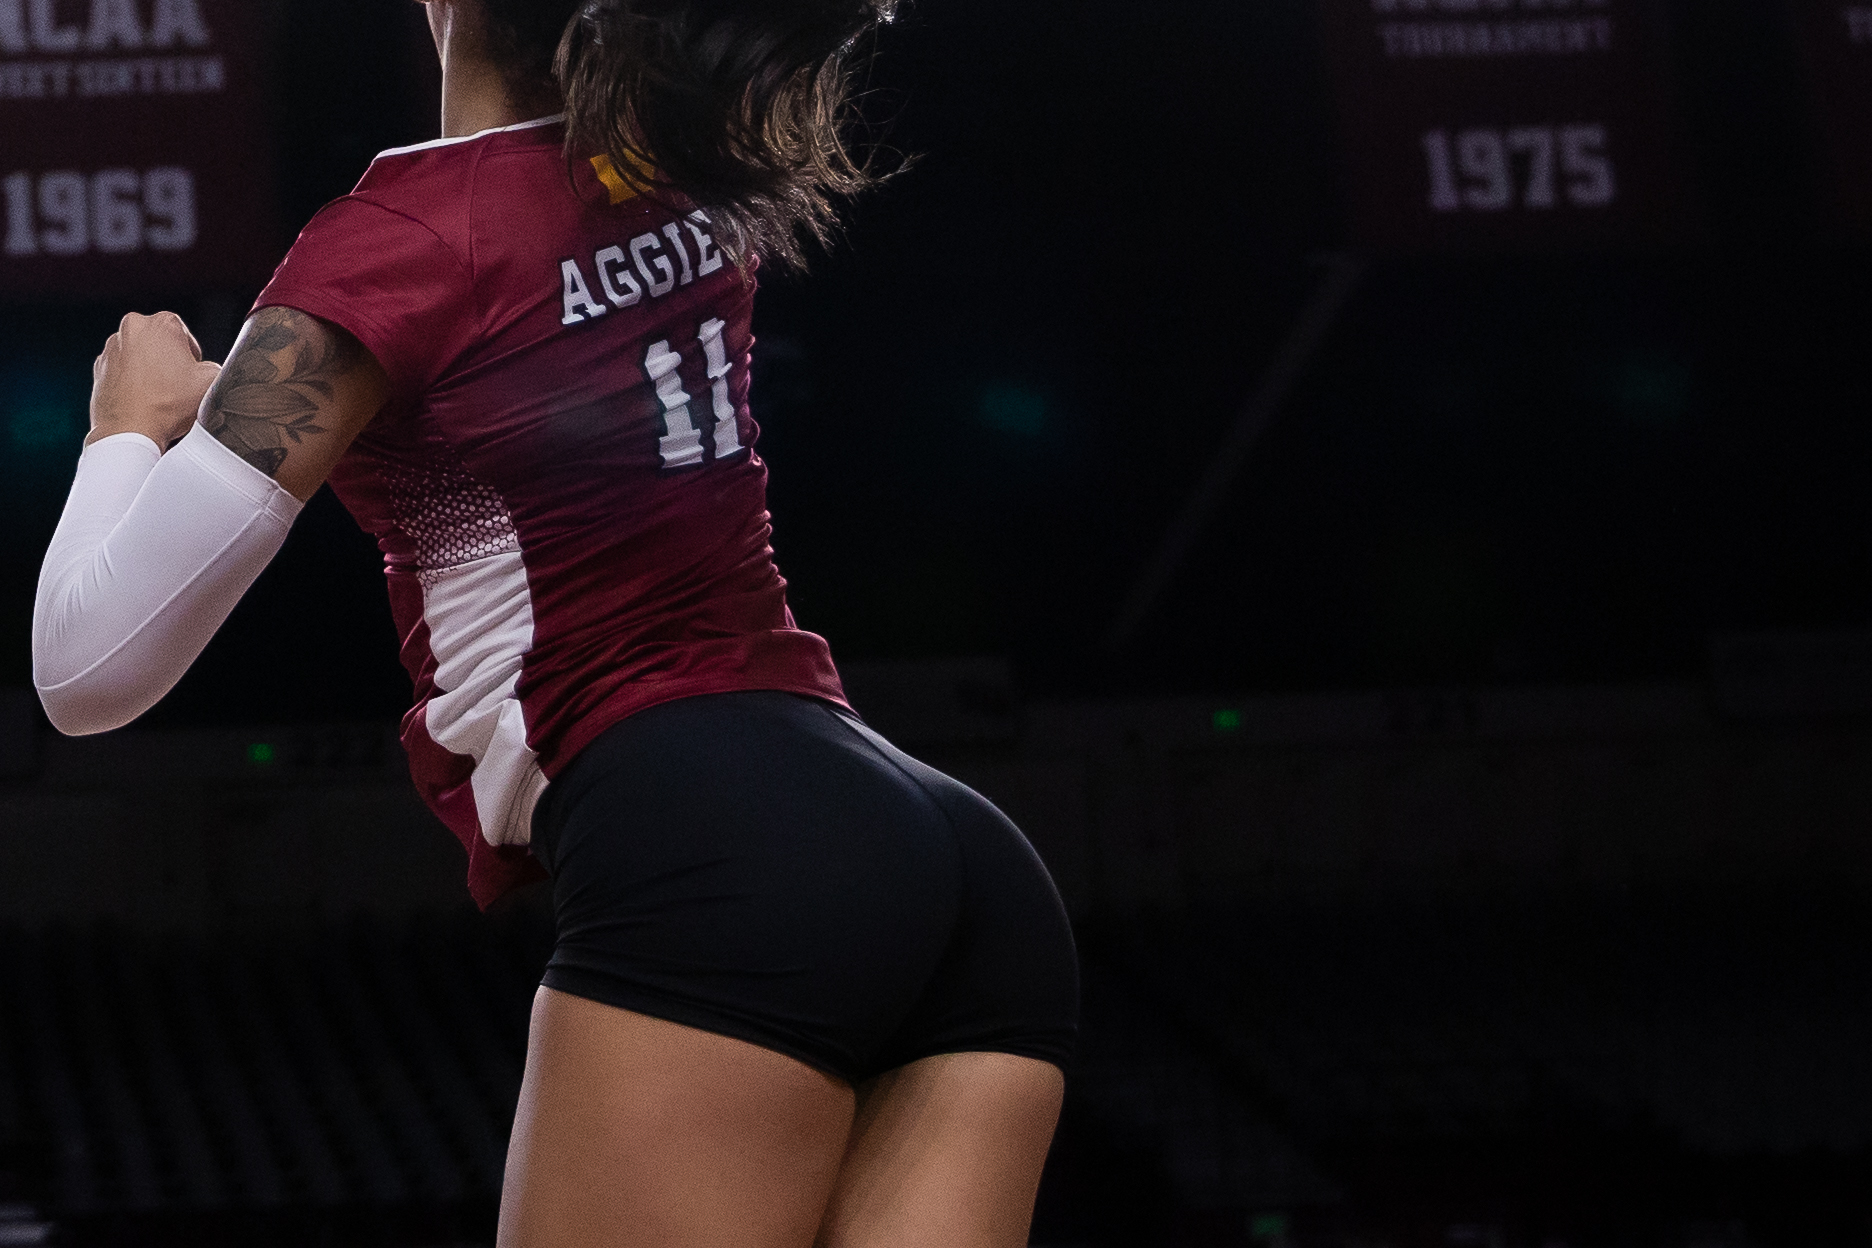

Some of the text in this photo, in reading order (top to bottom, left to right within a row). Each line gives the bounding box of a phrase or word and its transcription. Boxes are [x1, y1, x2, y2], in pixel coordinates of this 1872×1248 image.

[2, 165, 197, 256] 1969
[1424, 124, 1617, 210] 1975
[561, 209, 740, 324] AGGIE
[644, 317, 745, 468] 11
